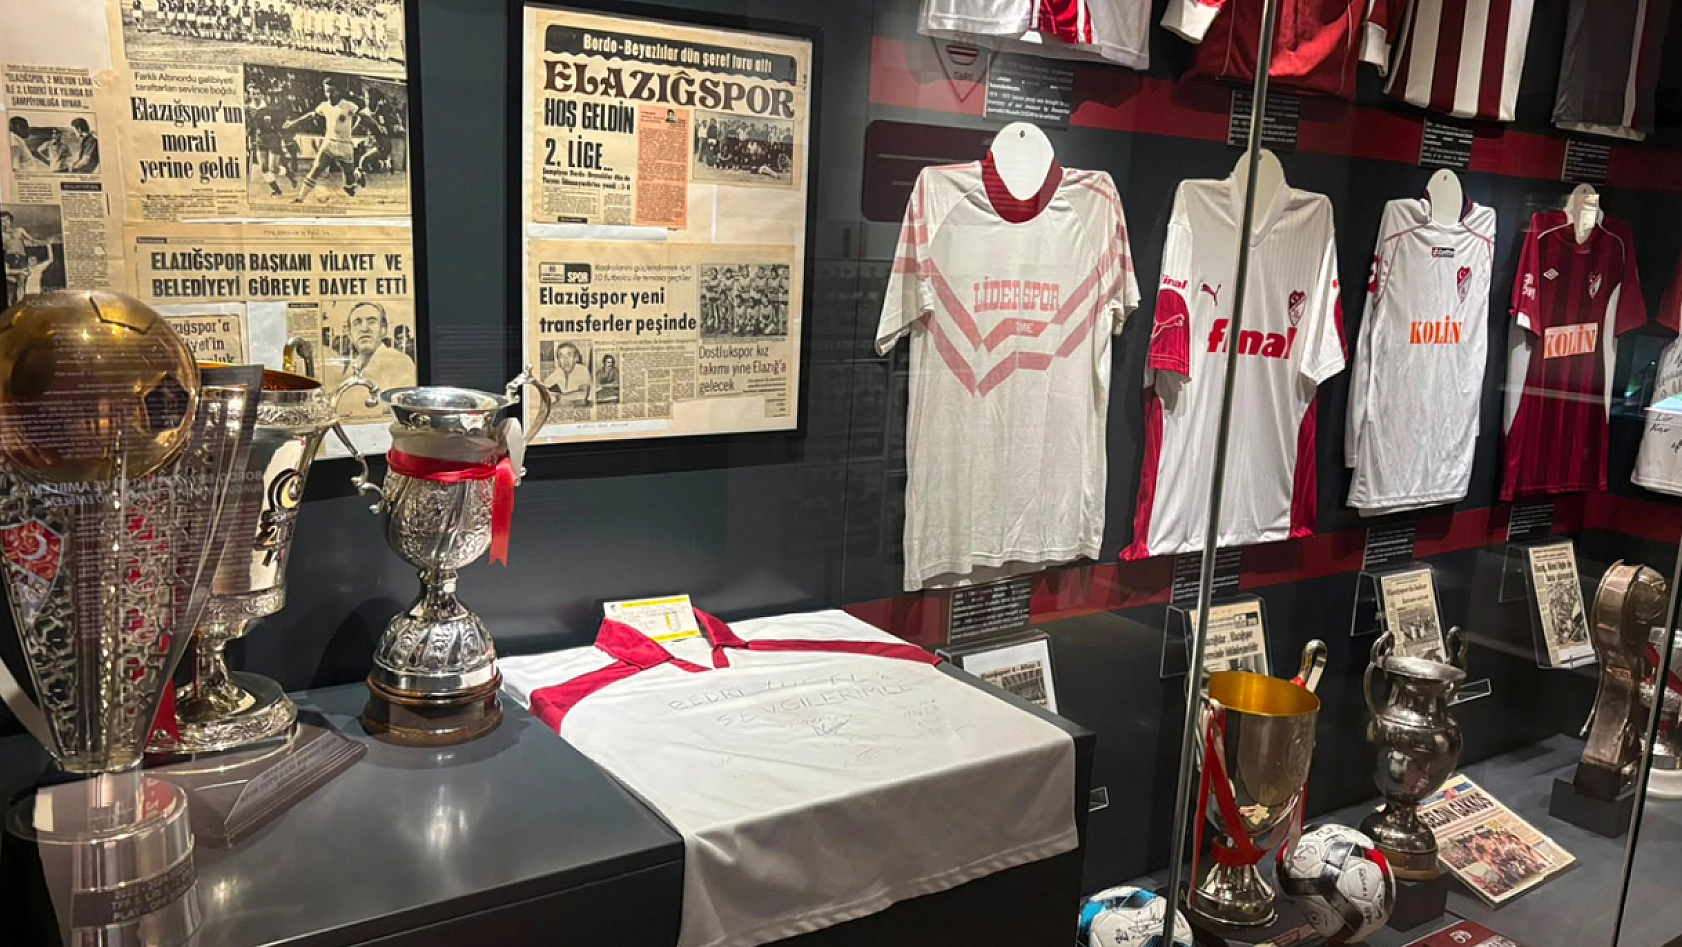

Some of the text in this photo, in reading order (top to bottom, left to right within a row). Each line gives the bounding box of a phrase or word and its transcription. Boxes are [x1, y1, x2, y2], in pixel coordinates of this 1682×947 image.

[130, 97, 243, 128] Elazığspor'un
[544, 97, 635, 134] HOŞ GELDİN
[162, 130, 217, 153] morali
[545, 138, 561, 167] 2.
[140, 156, 241, 184] yerine geldi
[151, 247, 402, 272] ELAZIĞSPOR BAŞKANI VİLAYET VE
[152, 274, 407, 297] BELEDİYEYİ GÖREVE DAVET ETTİ
[567, 271, 589, 282] SPOR
[539, 286, 665, 309] Elazığspor yeni
[1022, 280, 1060, 312] SPOR
[539, 312, 697, 335] transferler peşinde
[1410, 315, 1462, 344] KOLİN
[1207, 318, 1297, 359] fnal
[1544, 325, 1597, 357] KOLİN
[699, 345, 769, 360] Dostlukspor kız
[732, 361, 751, 377] yine
[753, 359, 787, 375] Elazığ'a
[699, 379, 735, 395] gelecek
